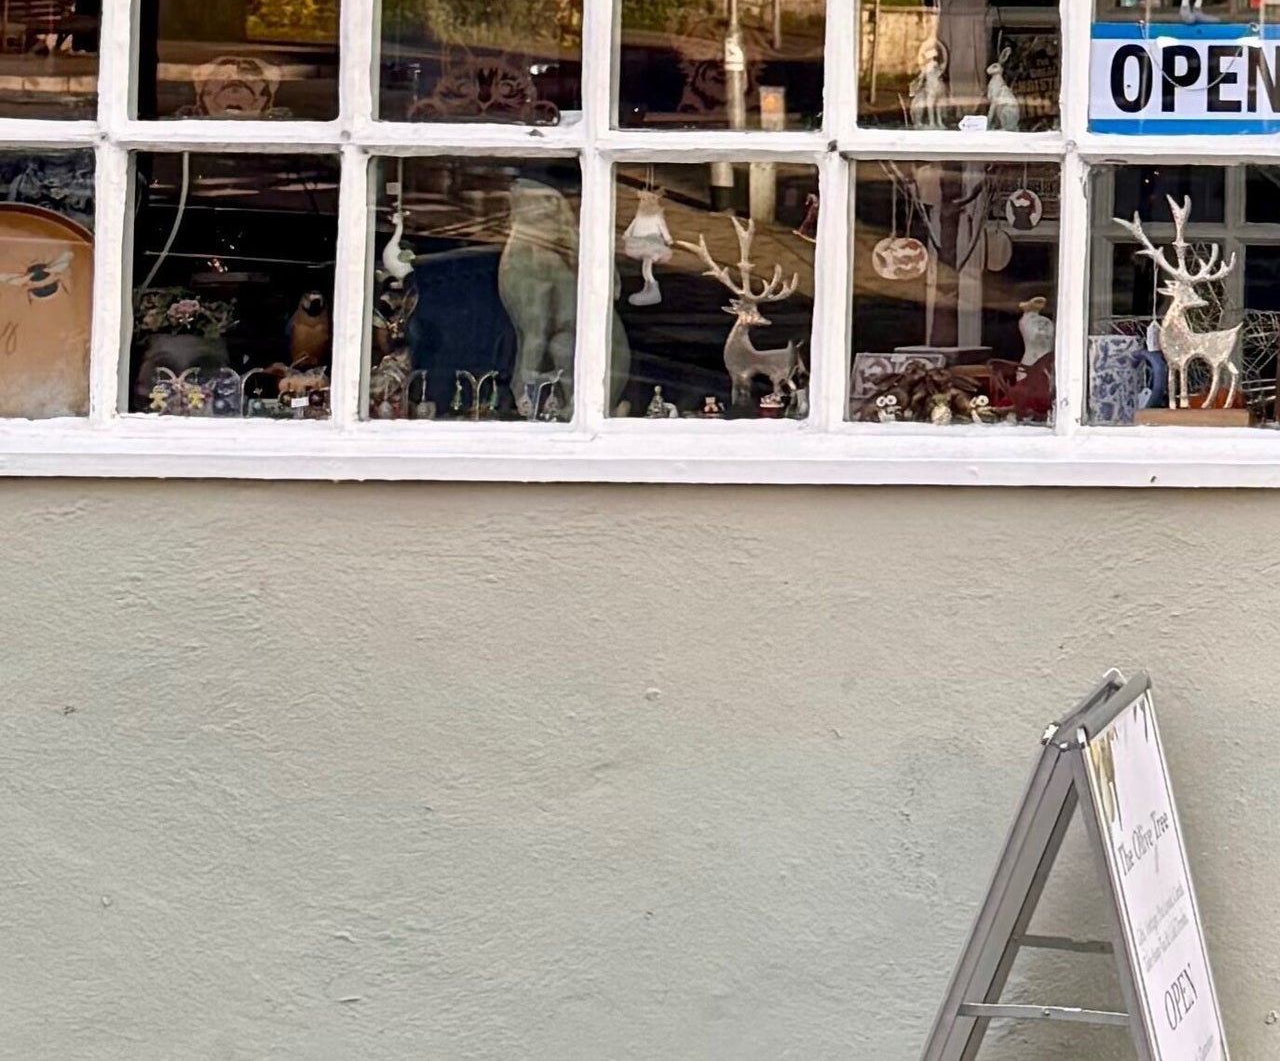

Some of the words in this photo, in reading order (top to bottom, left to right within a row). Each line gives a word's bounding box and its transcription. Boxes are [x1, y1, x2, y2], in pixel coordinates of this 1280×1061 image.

[1117, 842, 1134, 876] The
[1131, 823, 1154, 861] Olive
[1150, 811, 1169, 841] Tree
[1164, 962, 1198, 1031] OPEN
